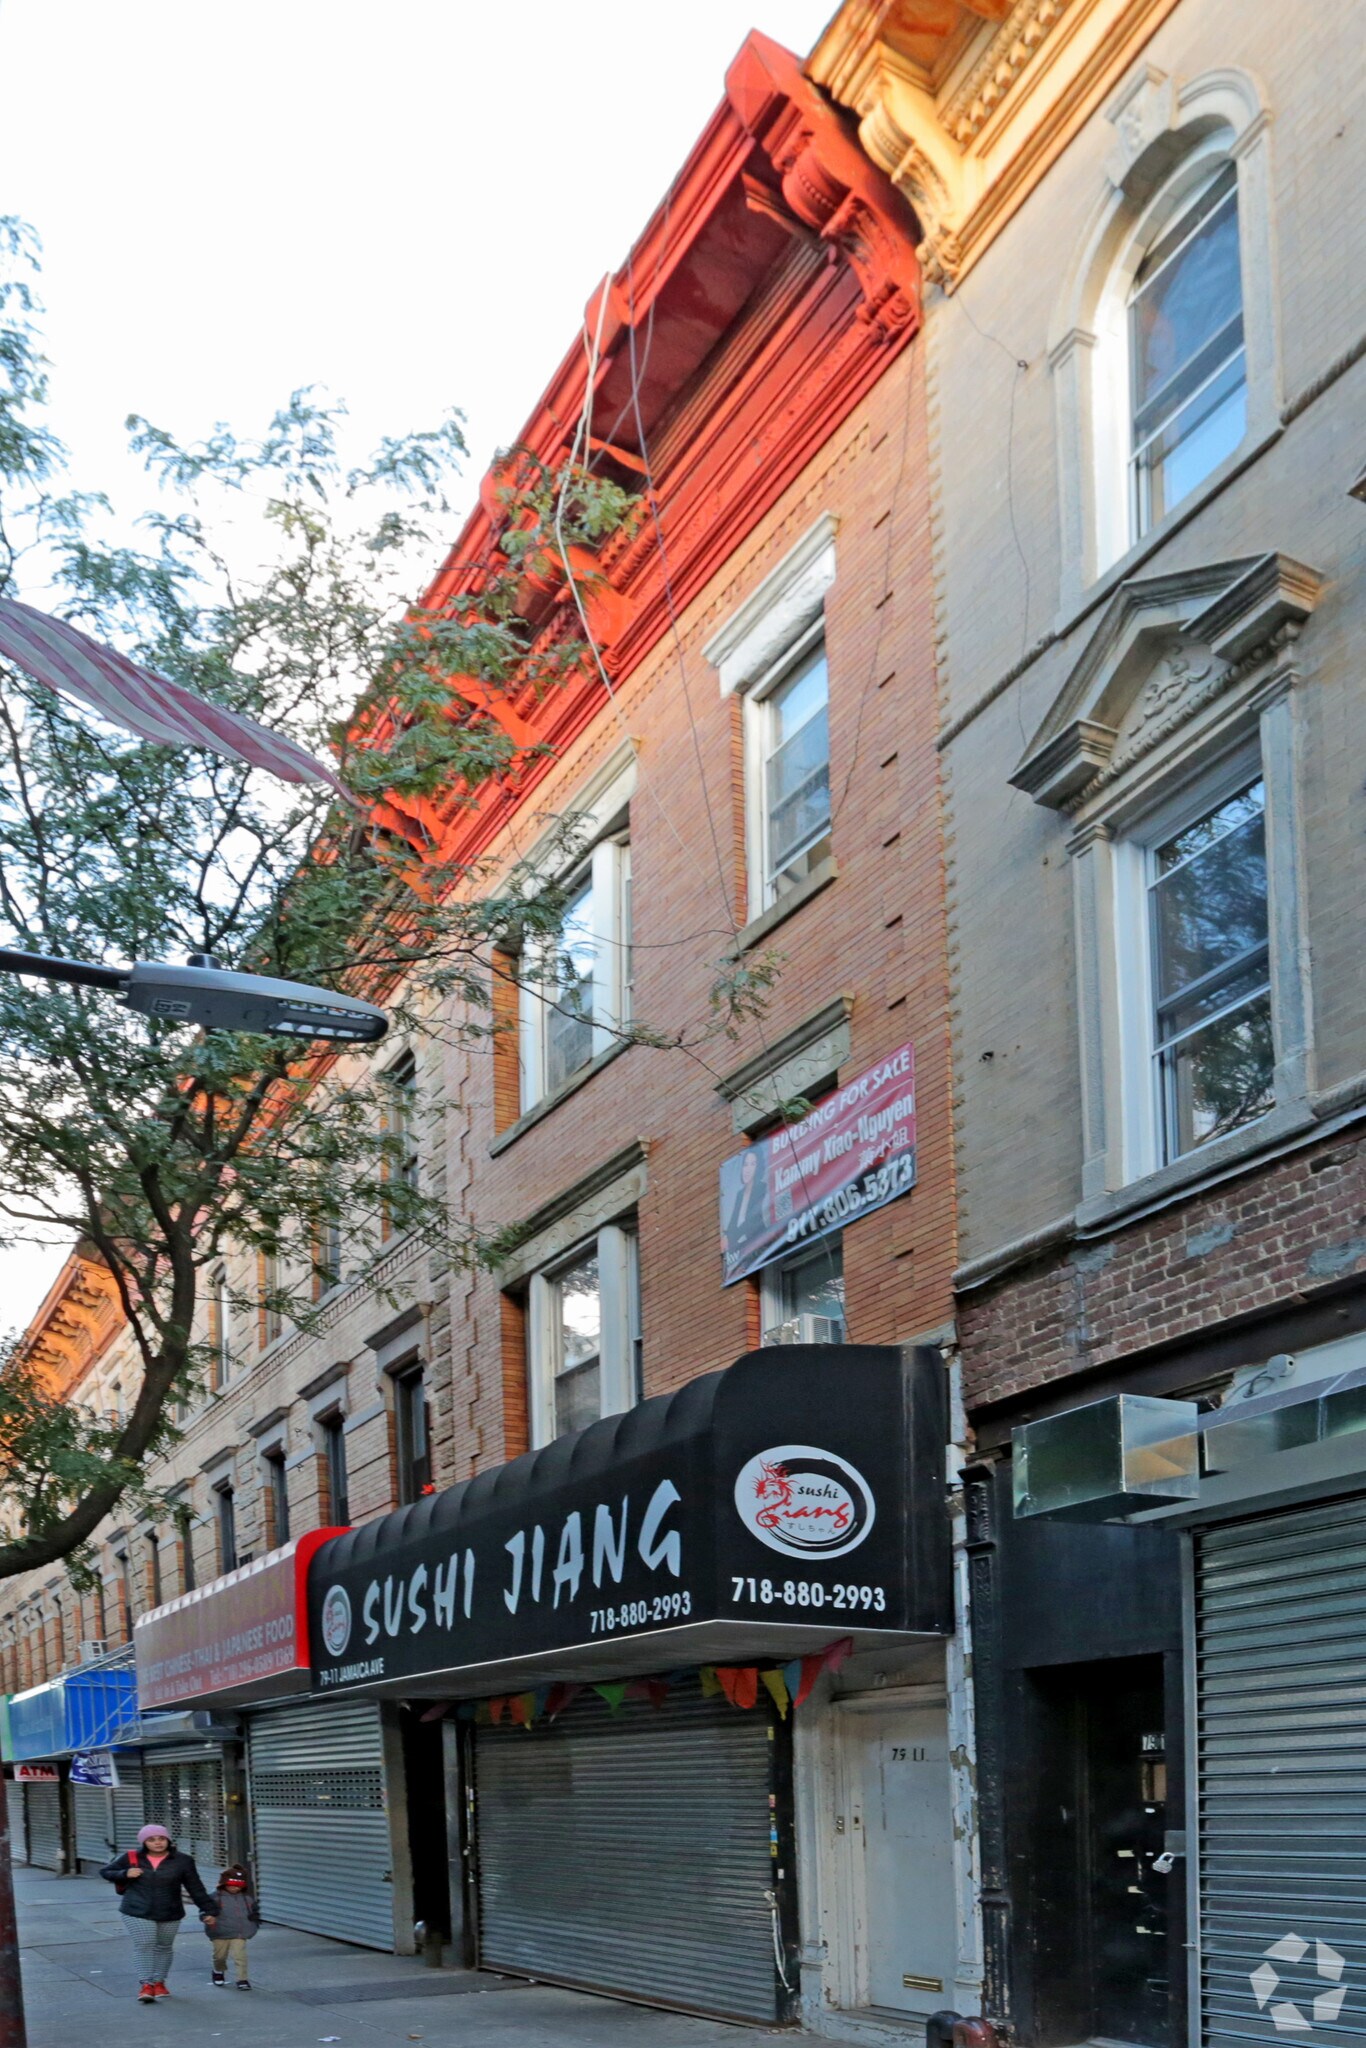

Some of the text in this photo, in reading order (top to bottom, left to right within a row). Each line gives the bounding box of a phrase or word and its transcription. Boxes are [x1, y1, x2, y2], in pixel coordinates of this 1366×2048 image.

[772, 1050, 911, 1154] BUILDING FOR SALE
[774, 1094, 914, 1191] Kammy Xiao-Nguyen
[797, 1483, 839, 1499] sushi
[363, 1548, 476, 1645] SUSHI
[503, 1479, 682, 1615] JIANG
[590, 1591, 692, 1634] 718-880-2993
[731, 1576, 886, 1612] 718-880-2993
[222, 1625, 263, 1662] JAPANESE
[265, 1613, 294, 1645] FOOD
[319, 1670, 338, 1686] 79-11
[339, 1661, 369, 1682] JAMAICA
[20, 1765, 55, 1776] ATM
